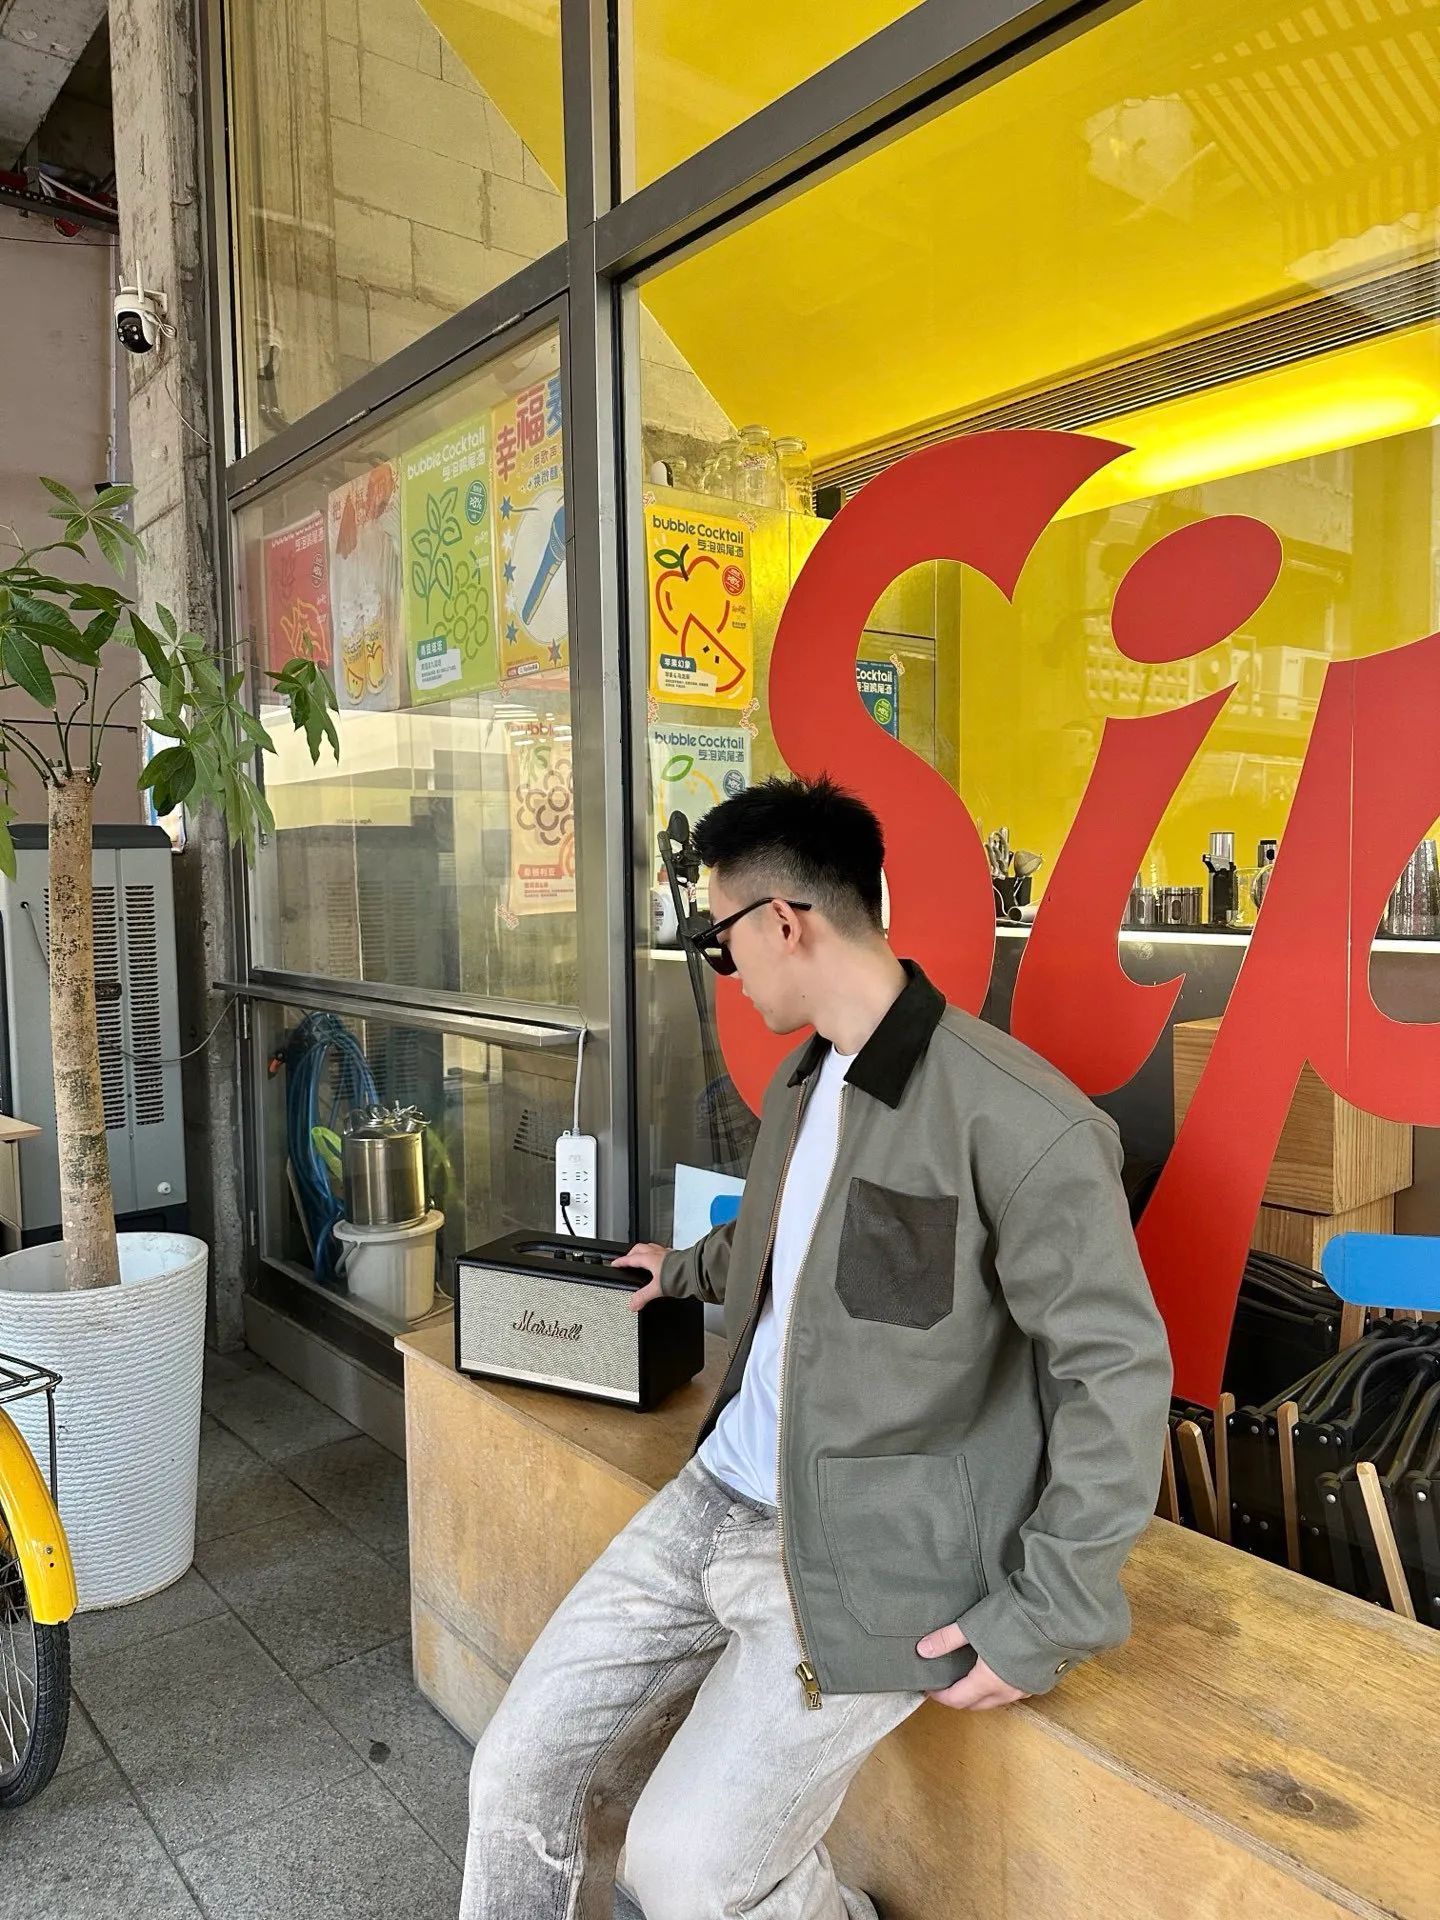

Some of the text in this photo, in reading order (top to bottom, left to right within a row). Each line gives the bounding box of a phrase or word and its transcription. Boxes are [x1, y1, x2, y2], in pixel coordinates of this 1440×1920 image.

[407, 425, 486, 481] bubble Cocktail
[653, 514, 744, 544] bubble Cocktail
[856, 668, 892, 682] Cocktail
[655, 731, 744, 749] bubble Cocktail
[512, 1310, 583, 1341] Marshall
